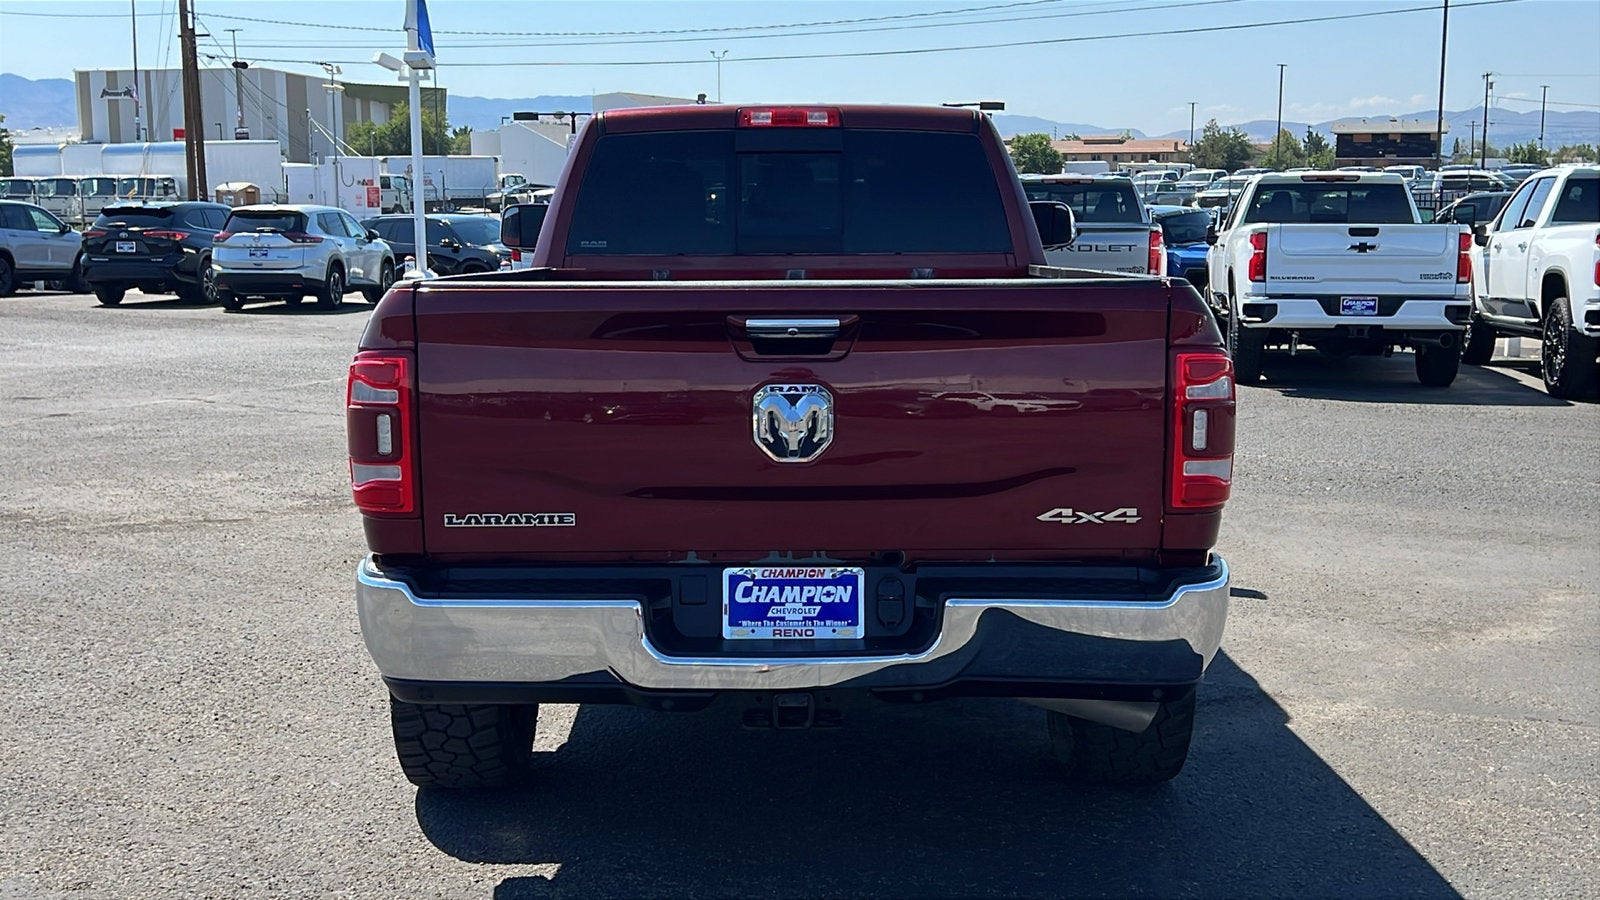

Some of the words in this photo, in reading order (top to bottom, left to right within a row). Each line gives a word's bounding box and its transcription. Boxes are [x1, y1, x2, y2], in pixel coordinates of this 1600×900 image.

[444, 513, 575, 527] LARAMIE
[1036, 508, 1142, 523] 4x4
[761, 568, 826, 578] CHAMPION
[734, 581, 853, 603] CHAMPION
[770, 607, 817, 615] CHEVROLET
[772, 628, 815, 637] RENO
